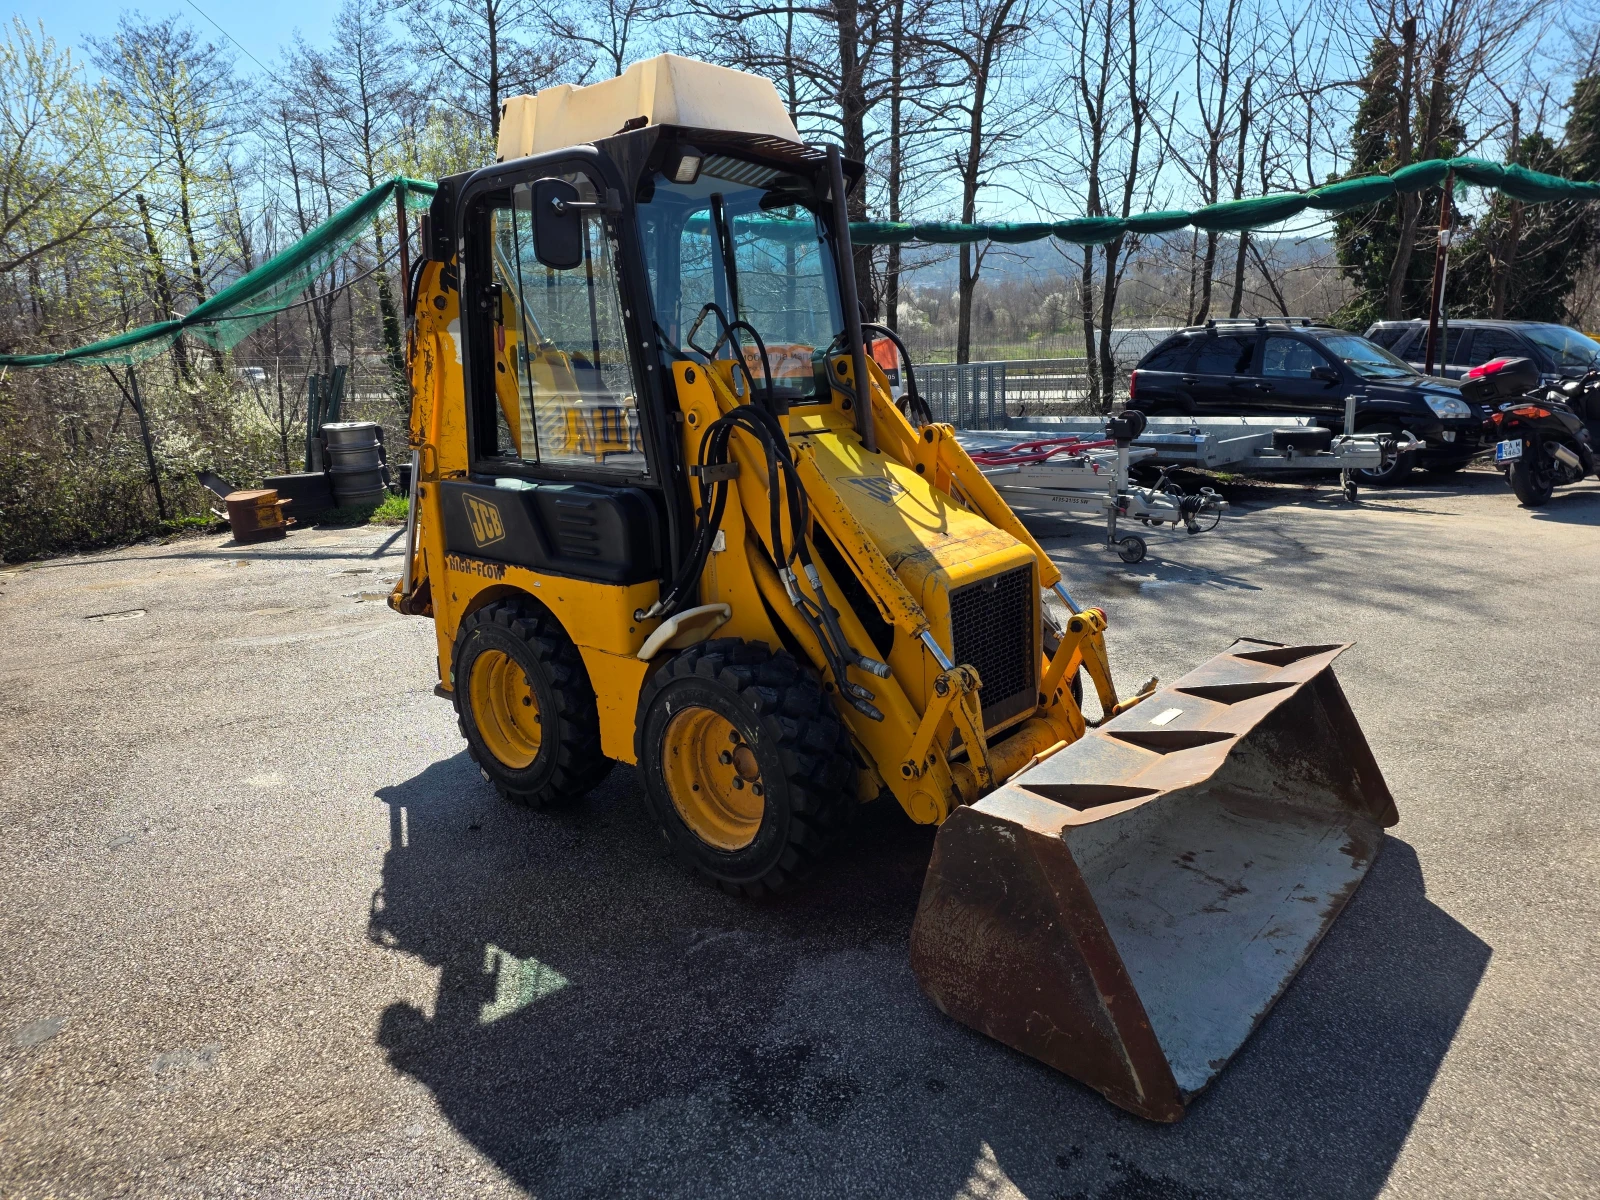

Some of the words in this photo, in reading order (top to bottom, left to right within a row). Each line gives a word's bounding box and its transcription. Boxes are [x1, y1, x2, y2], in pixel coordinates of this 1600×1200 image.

[775, 353, 788, 361] на
[790, 352, 812, 361] изп
[848, 477, 904, 503] JCB
[468, 499, 502, 541] JCB
[449, 557, 504, 580] HIGH-FLOW
